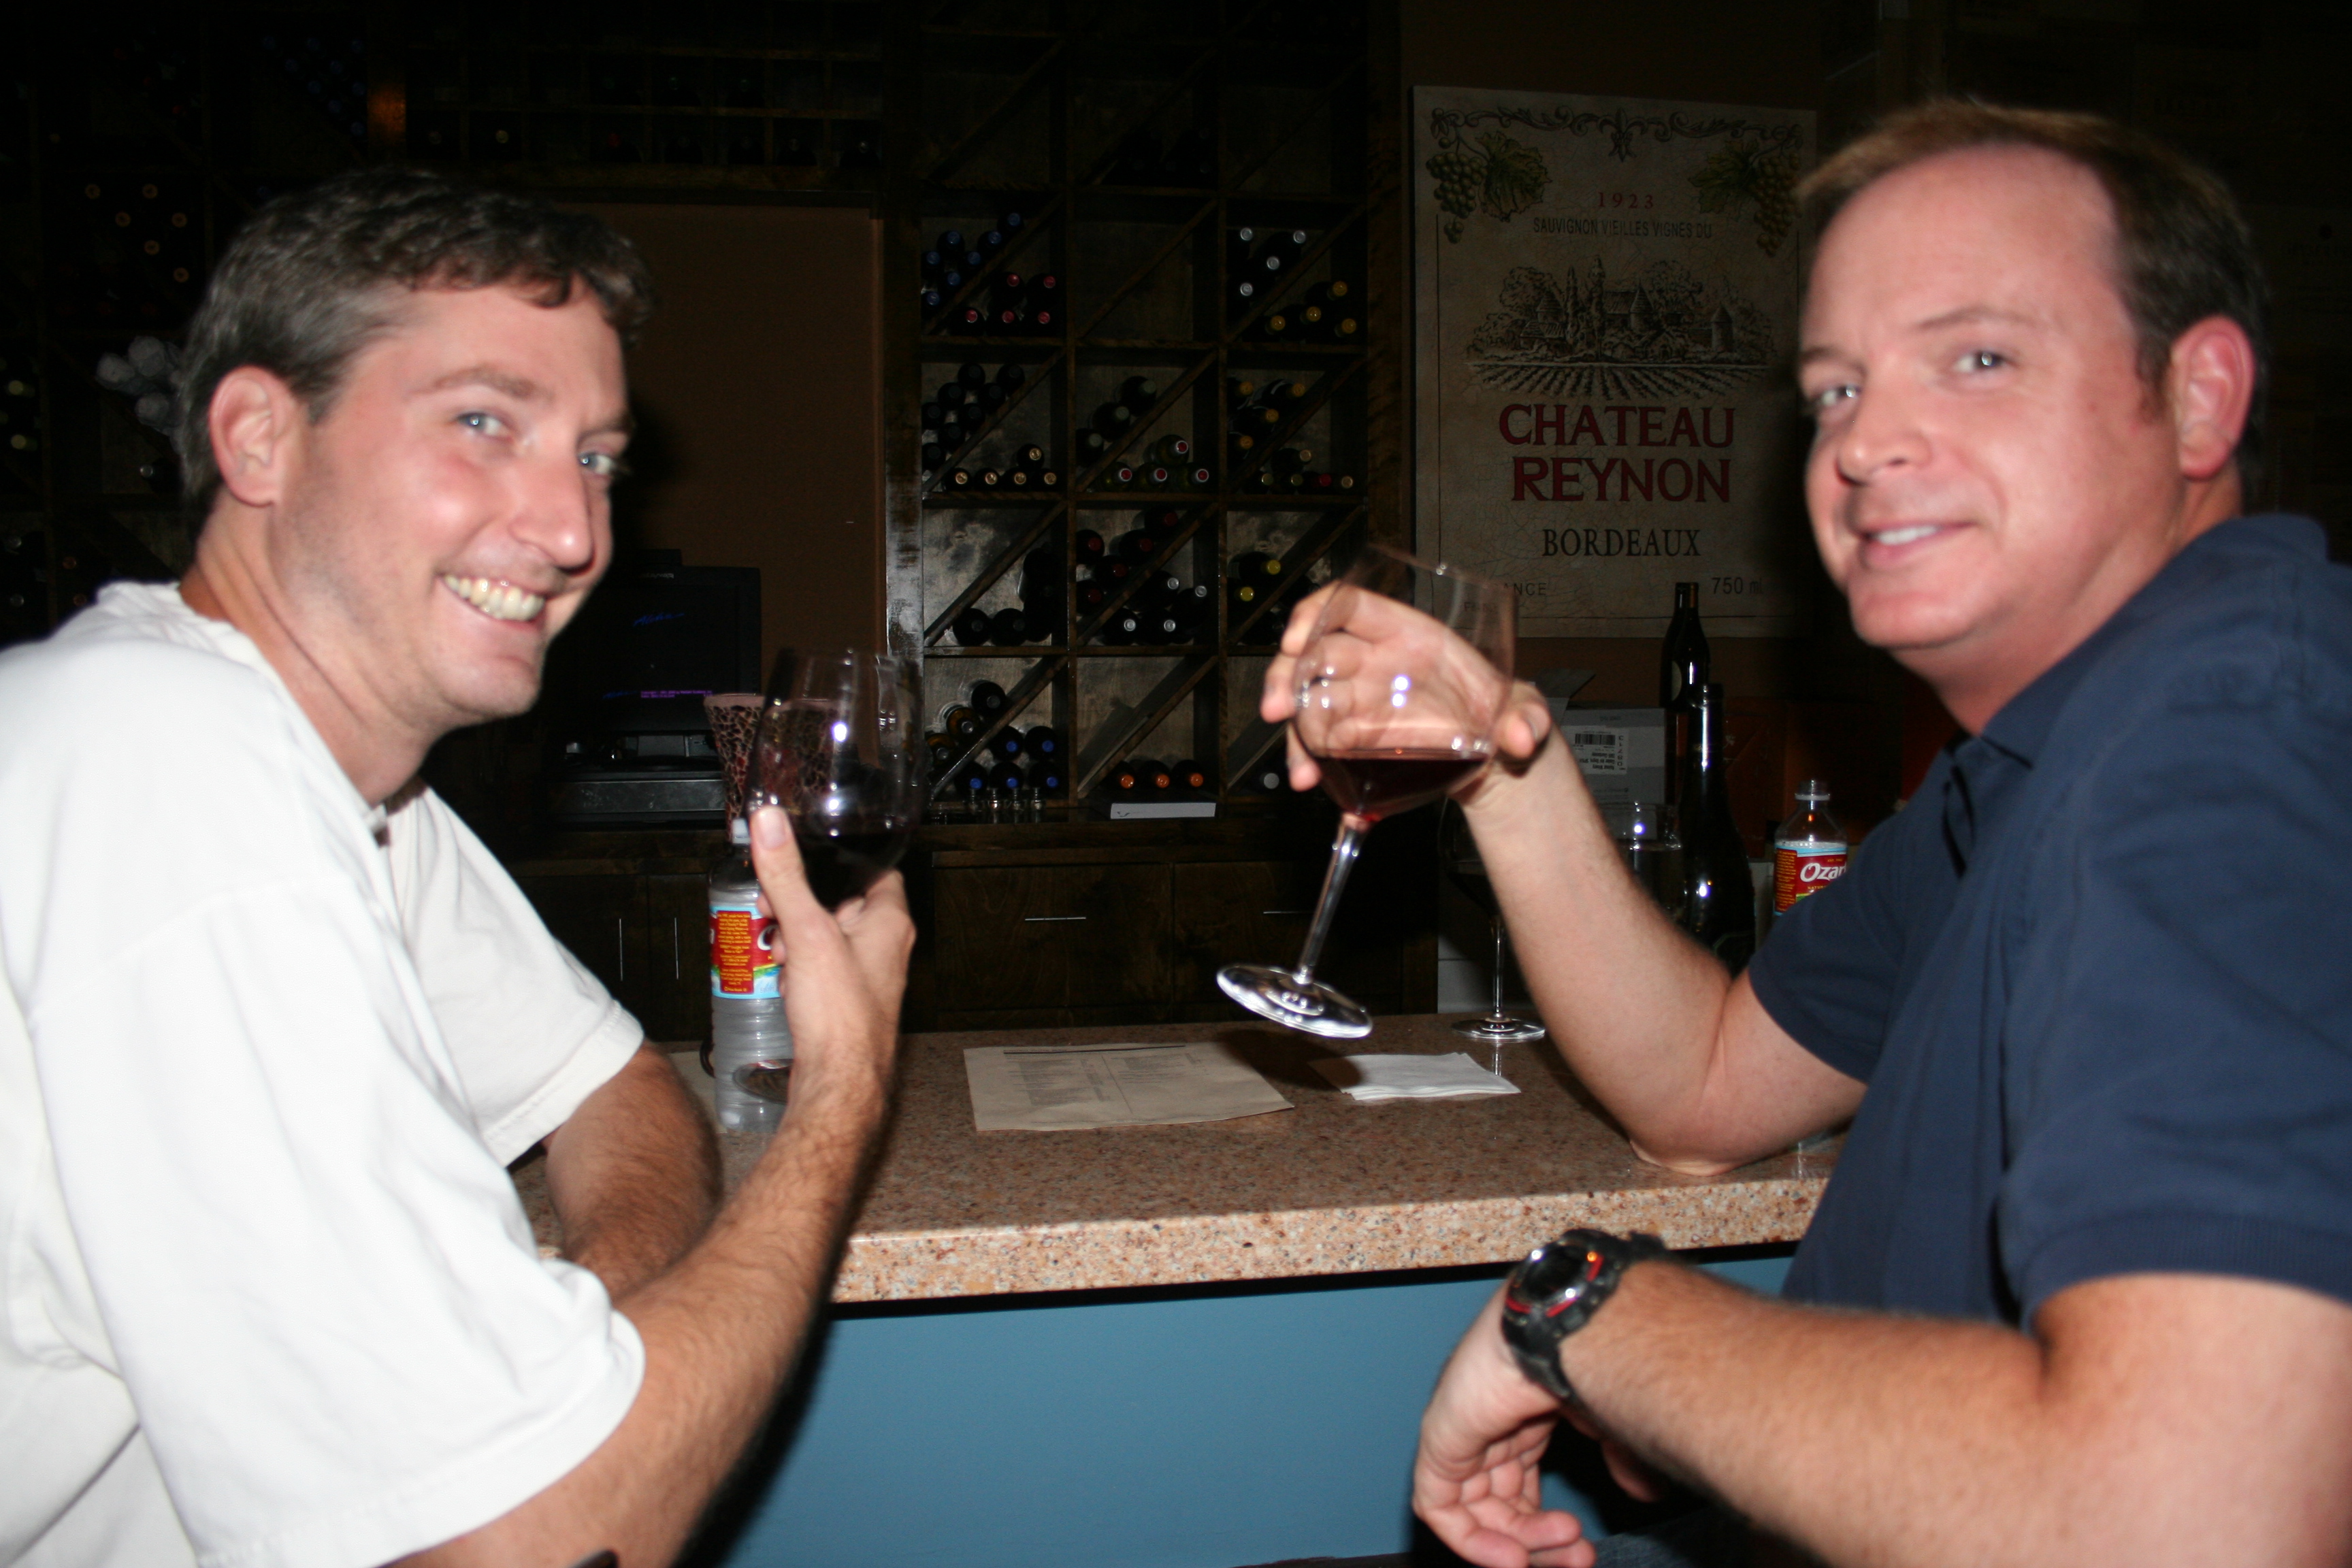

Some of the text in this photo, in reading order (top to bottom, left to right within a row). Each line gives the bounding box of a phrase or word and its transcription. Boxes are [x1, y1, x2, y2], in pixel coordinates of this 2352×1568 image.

[1598, 192, 1654, 209] 1923
[1533, 218, 1712, 239] SAUVIGNON VIEILLES VIGNES DU
[1499, 404, 1735, 448] CHATEAU
[1512, 457, 1731, 502] REYNON
[1542, 529, 1701, 557] BORDEAUX
[1711, 577, 1744, 594] 750
[1800, 862, 1846, 883] Ozar
